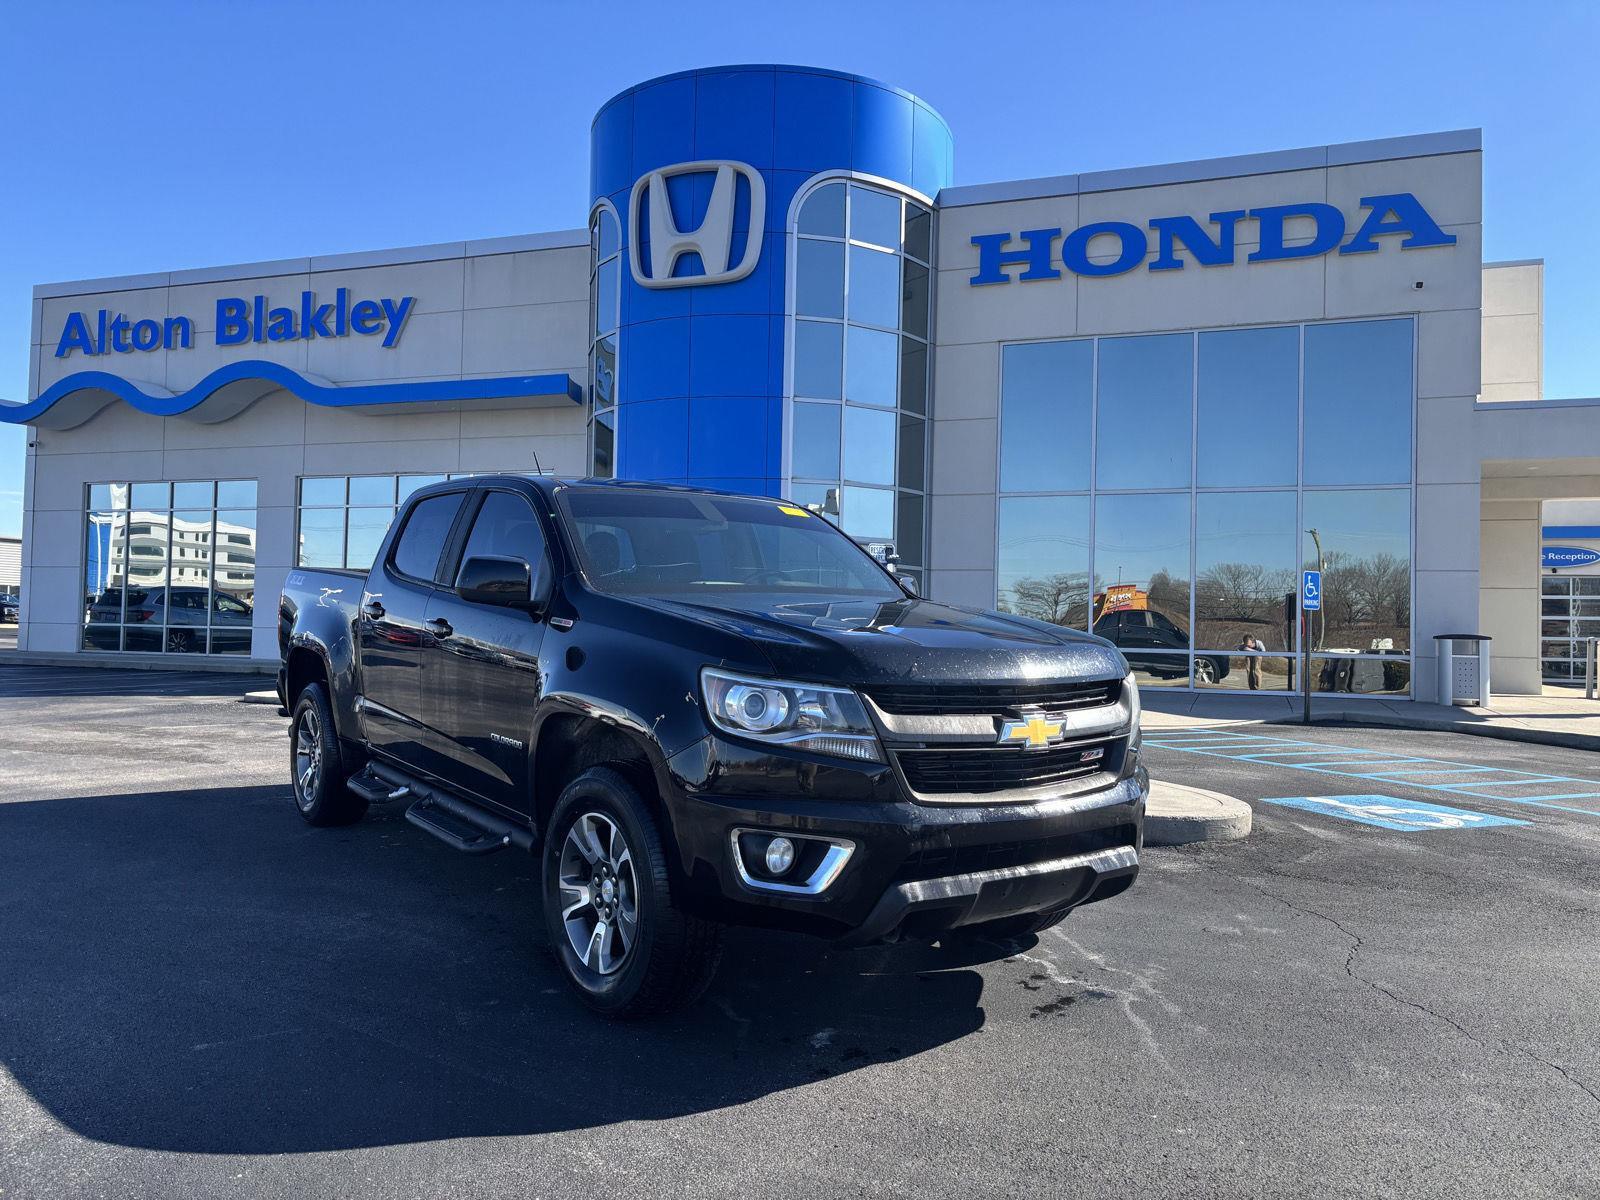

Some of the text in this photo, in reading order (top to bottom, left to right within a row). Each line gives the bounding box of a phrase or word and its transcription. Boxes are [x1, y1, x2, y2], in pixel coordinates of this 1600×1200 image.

[970, 193, 1457, 286] HONDA
[55, 287, 415, 358] Alton Blakley
[1548, 552, 1596, 562] Reception
